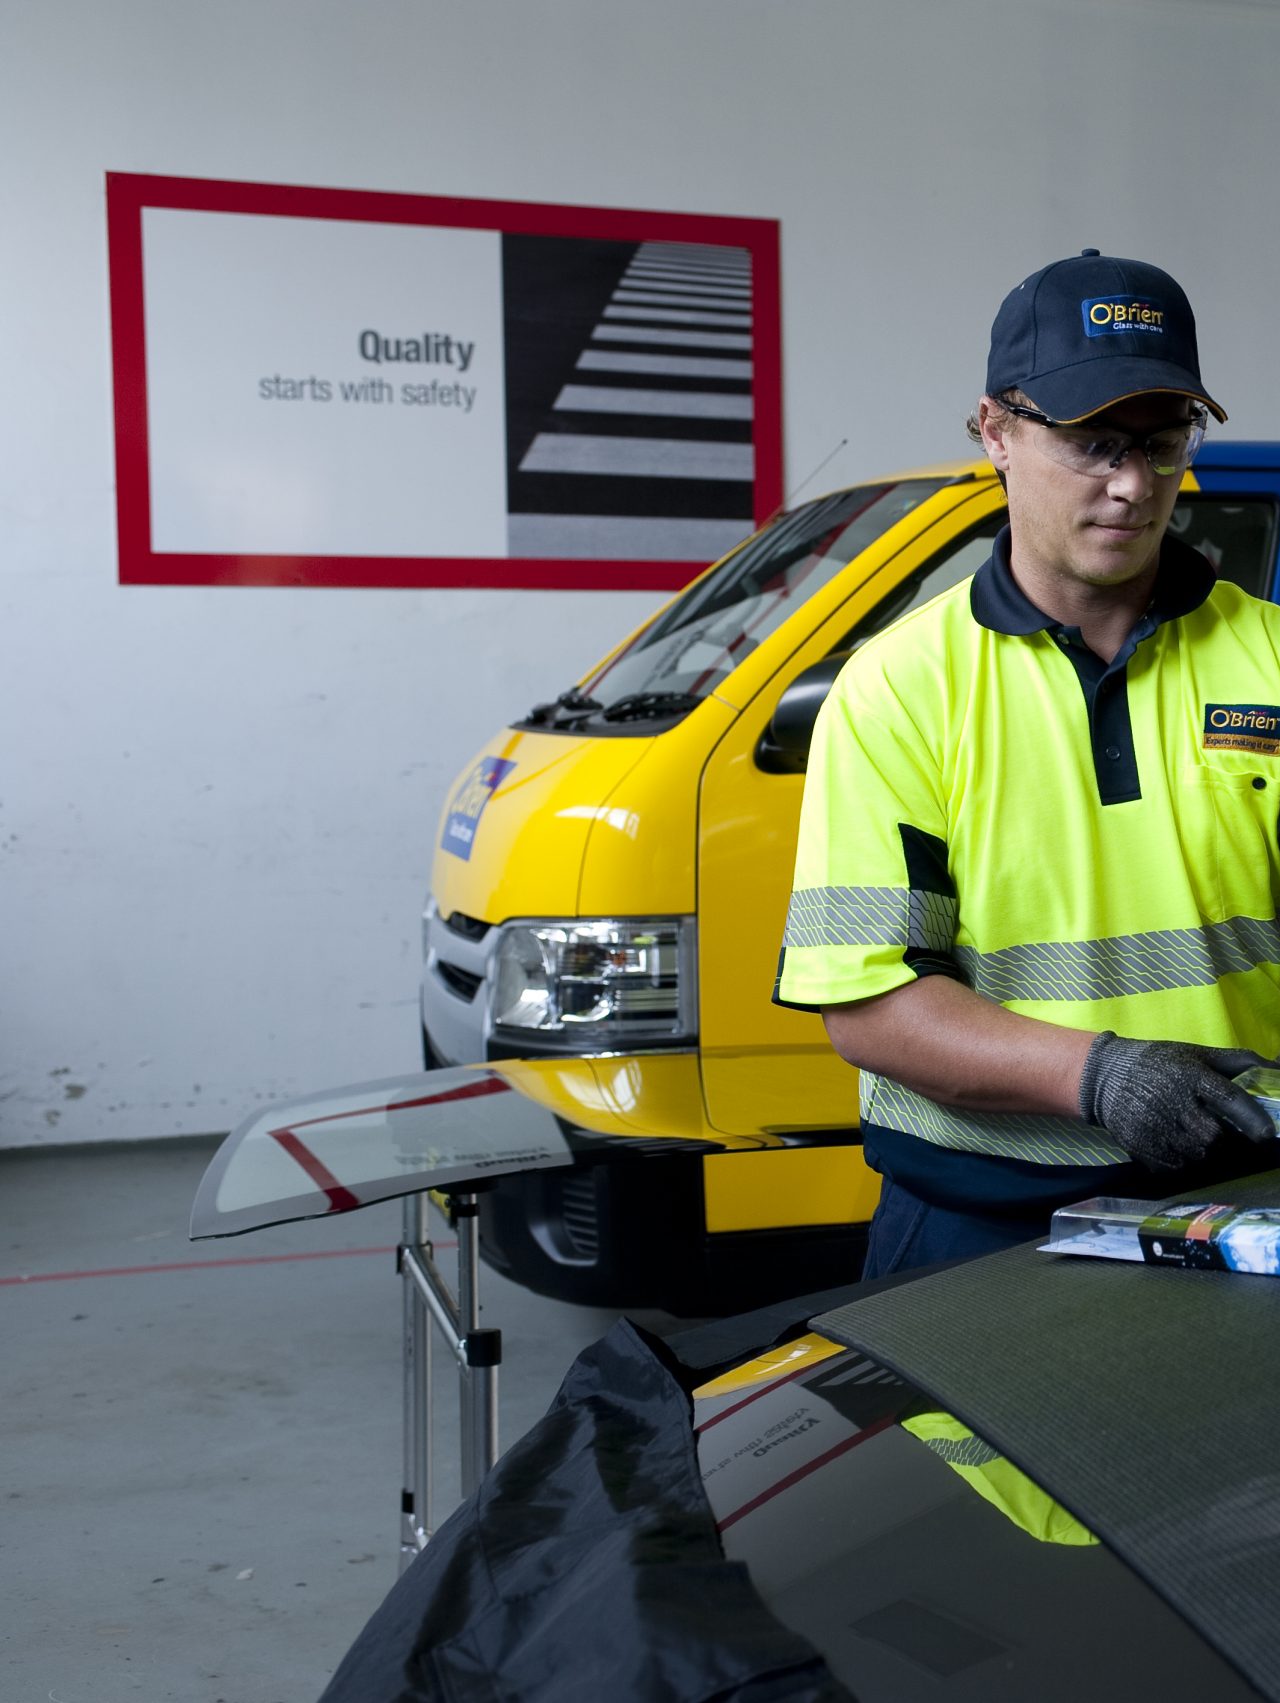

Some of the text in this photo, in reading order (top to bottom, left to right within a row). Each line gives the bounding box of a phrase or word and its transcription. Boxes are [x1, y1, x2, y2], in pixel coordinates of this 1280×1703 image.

[1090, 303, 1163, 325] O'Brien
[1113, 321, 1133, 330] Glass
[1133, 323, 1150, 331] with
[358, 329, 475, 372] Quality
[258, 373, 478, 414] starts with safety
[1210, 709, 1278, 731] O'Brien
